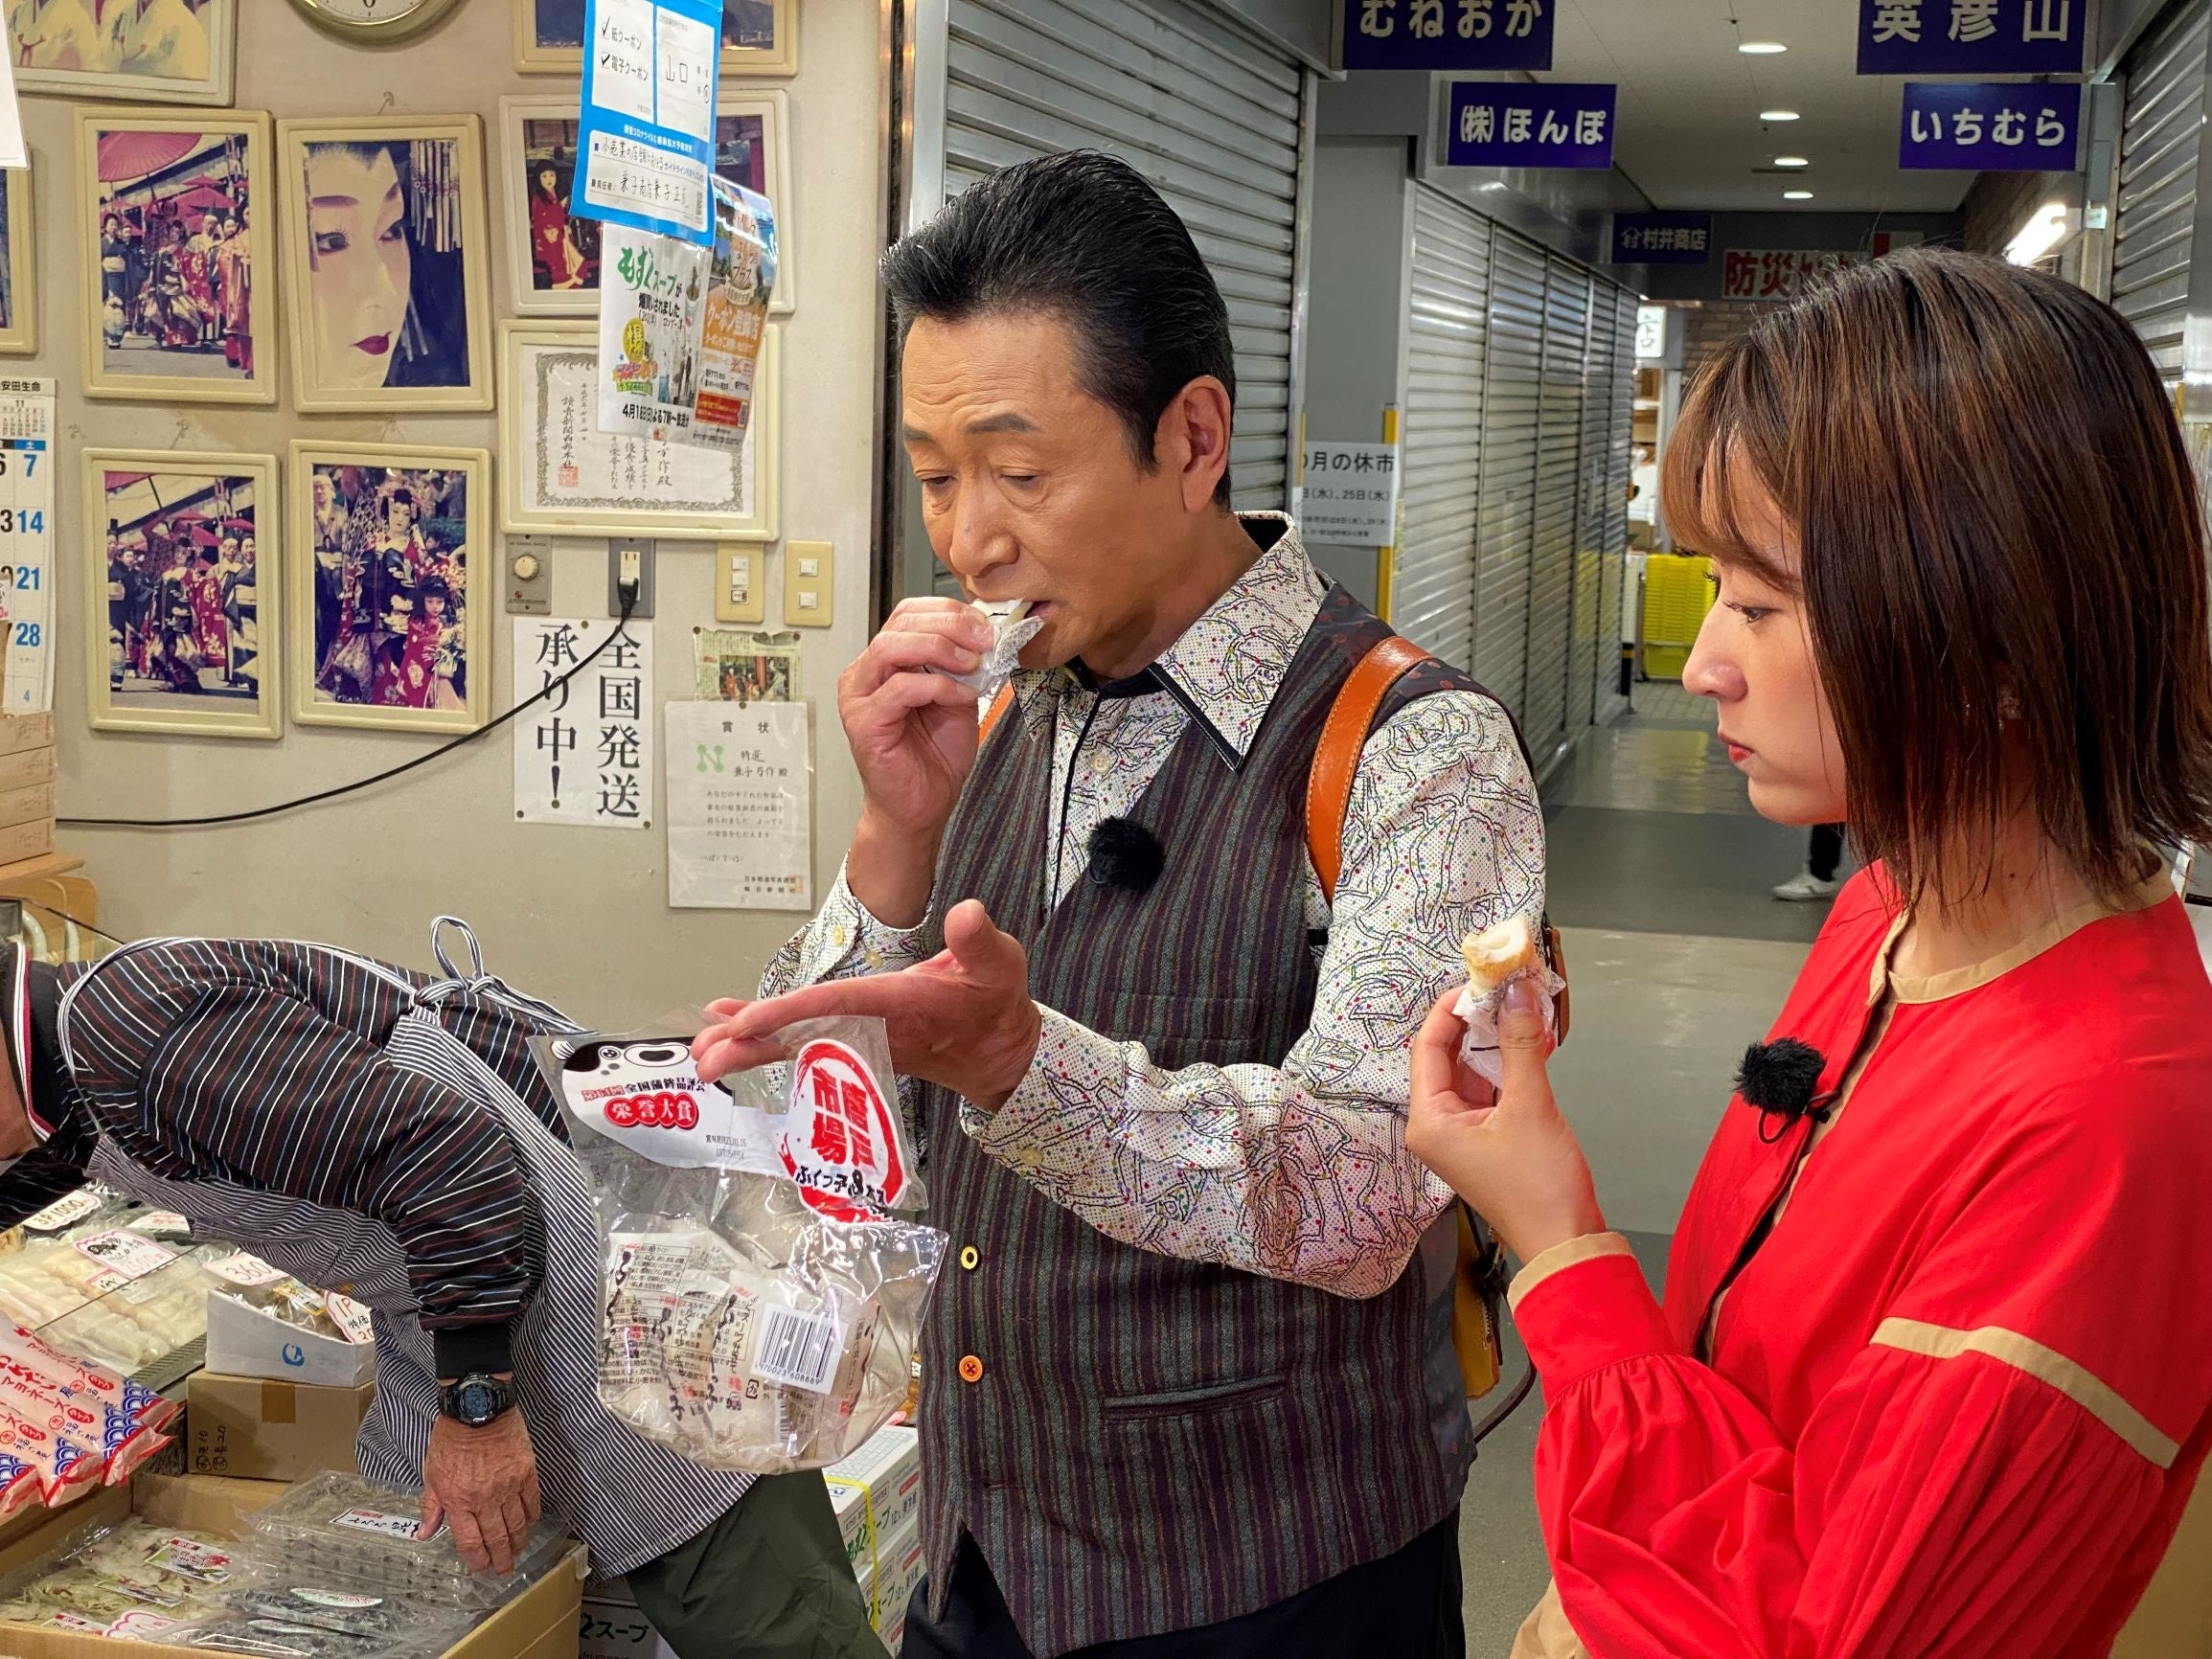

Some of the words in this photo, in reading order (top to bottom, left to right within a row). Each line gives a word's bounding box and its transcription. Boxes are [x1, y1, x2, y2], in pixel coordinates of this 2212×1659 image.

[1360, 0, 1542, 38] むねおか
[1873, 0, 2069, 43] 英彦山
[611, 27, 642, 50] 紙クーポン
[611, 56, 649, 81] 電子クーポン
[1910, 108, 2064, 147] いちむら
[1642, 227, 1707, 251] 村井商店
[1, 380, 41, 392] 安田生命
[24, 454, 37, 477] 7
[17, 510, 44, 534] 14
[16, 566, 40, 590] 21
[15, 623, 40, 647] 28
[24, 689, 31, 702] 4
[596, 625, 642, 820] 全国発送
[611, 1098, 693, 1123] 栄誉大賞
